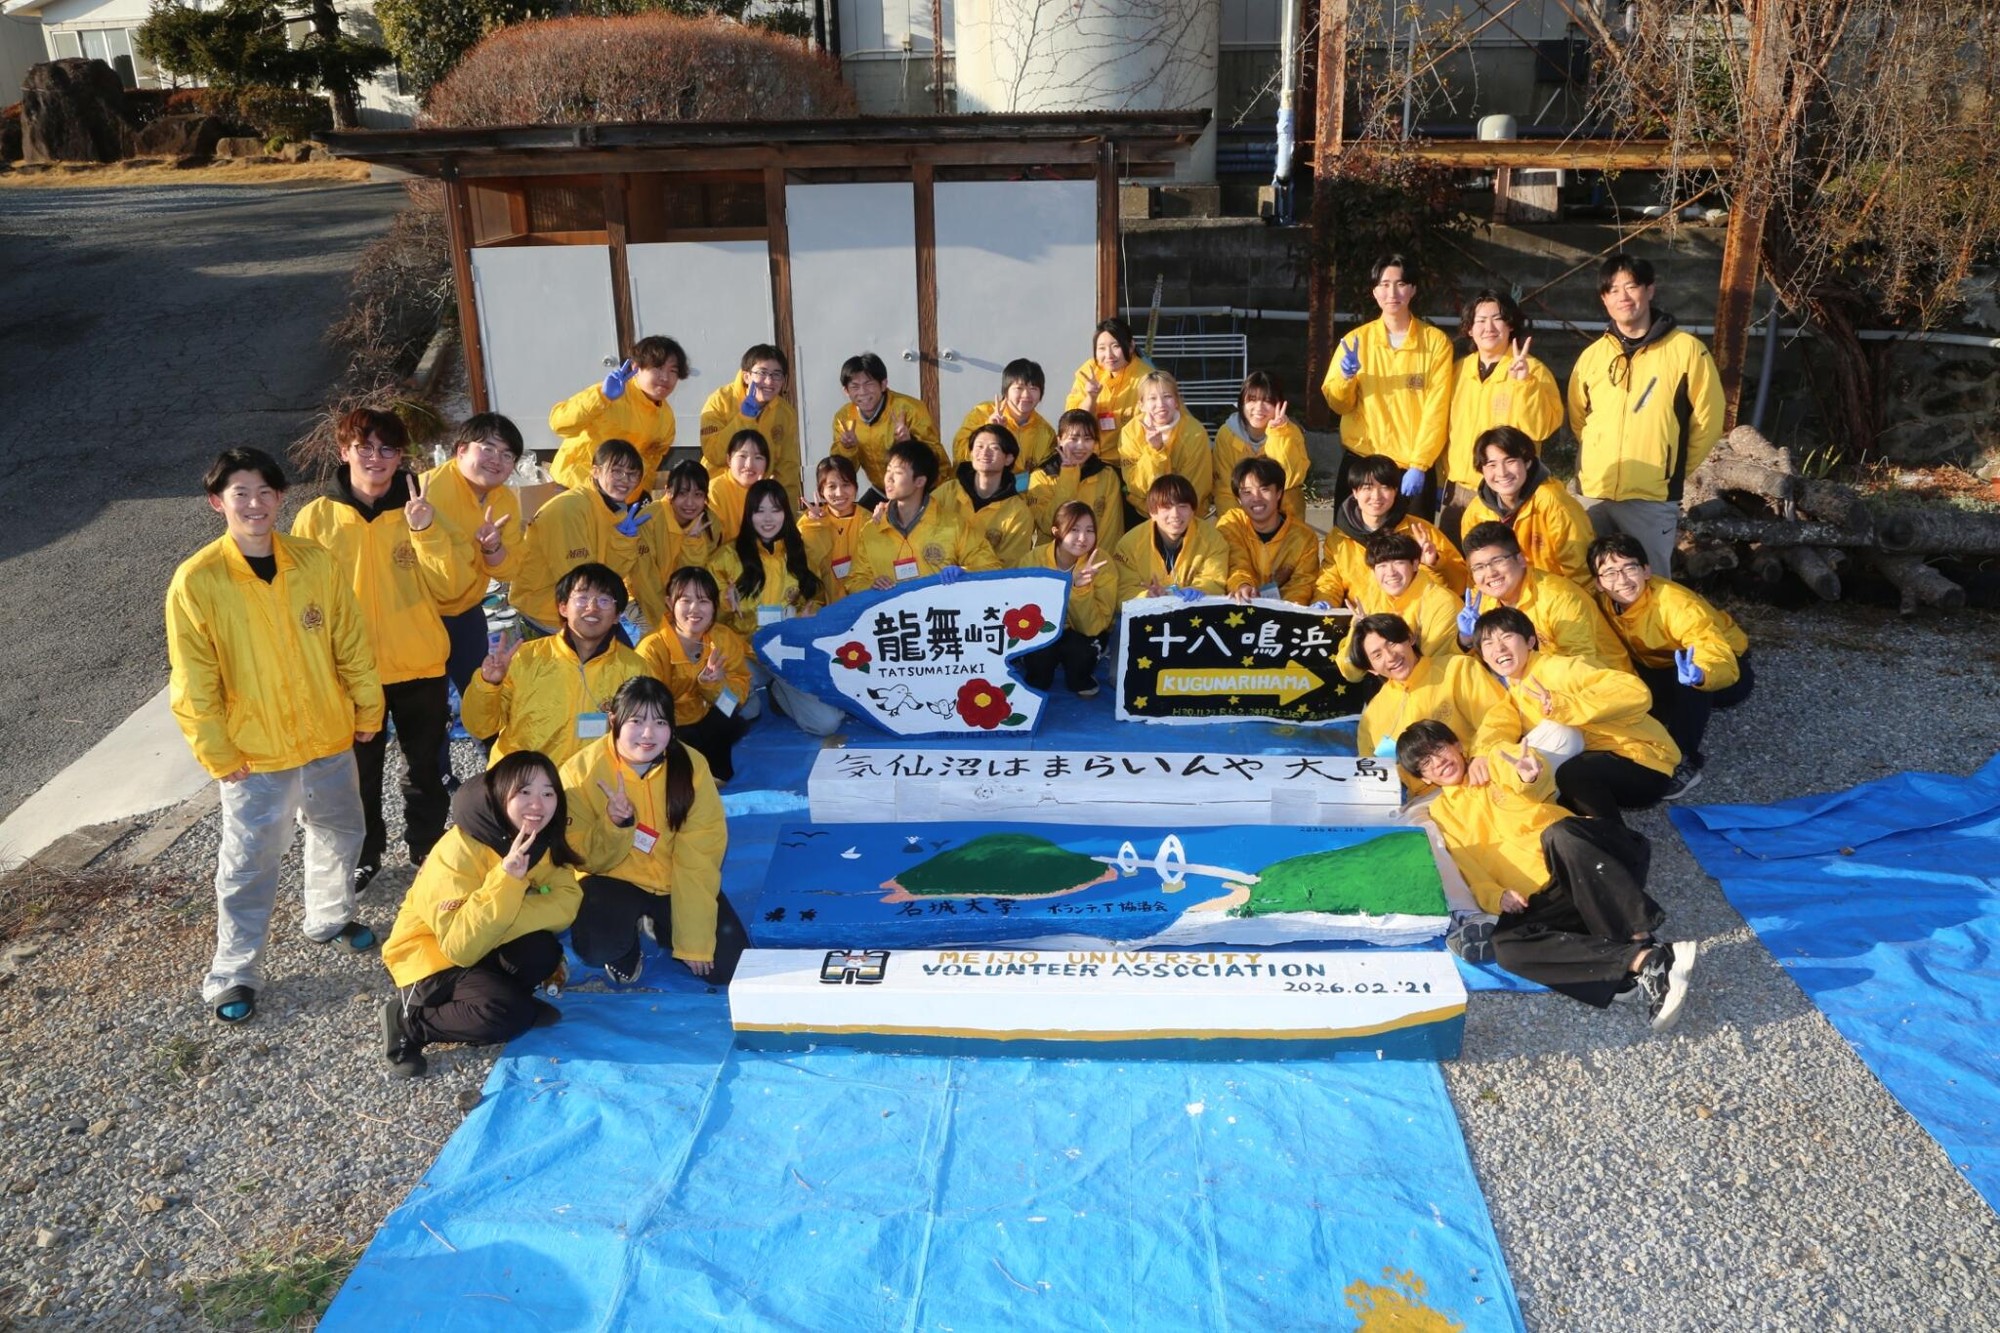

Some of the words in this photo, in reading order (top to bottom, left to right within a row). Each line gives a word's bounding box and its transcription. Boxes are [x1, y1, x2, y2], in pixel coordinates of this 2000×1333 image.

[873, 607, 1006, 663] 龍舞崎
[1149, 619, 1332, 658] 十八鳴浜
[878, 663, 986, 678] TATSUMAIZAKI
[1162, 674, 1311, 692] KUGUNARIHAMA
[896, 898, 1020, 917] 名城大学
[938, 951, 1039, 964] MEIJO
[1068, 952, 1263, 965] UNIVERSITY
[922, 963, 1099, 976] VOLUNTEER
